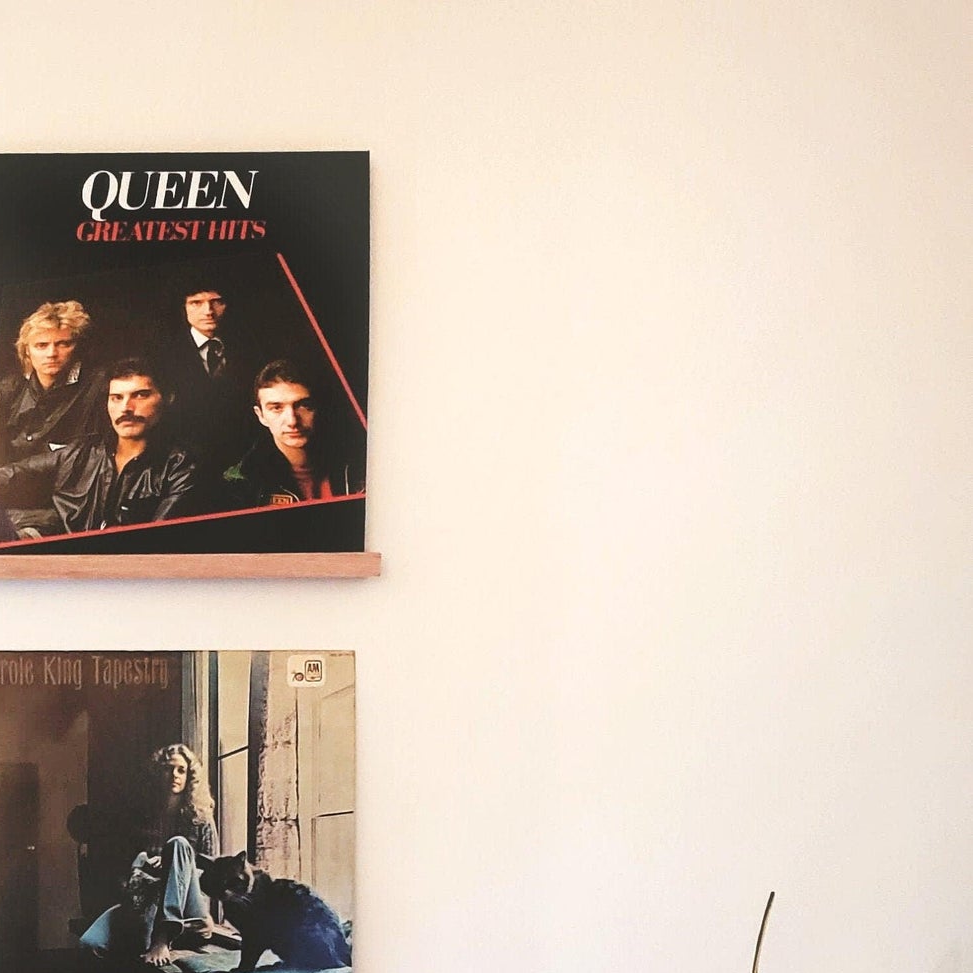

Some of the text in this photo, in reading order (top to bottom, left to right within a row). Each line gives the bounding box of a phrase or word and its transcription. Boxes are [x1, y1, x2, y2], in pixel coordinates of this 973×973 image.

[82, 170, 260, 222] QUEEN
[76, 219, 267, 242] GREATEST HITS
[43, 656, 82, 690] King
[91, 655, 169, 689] Tapestry
